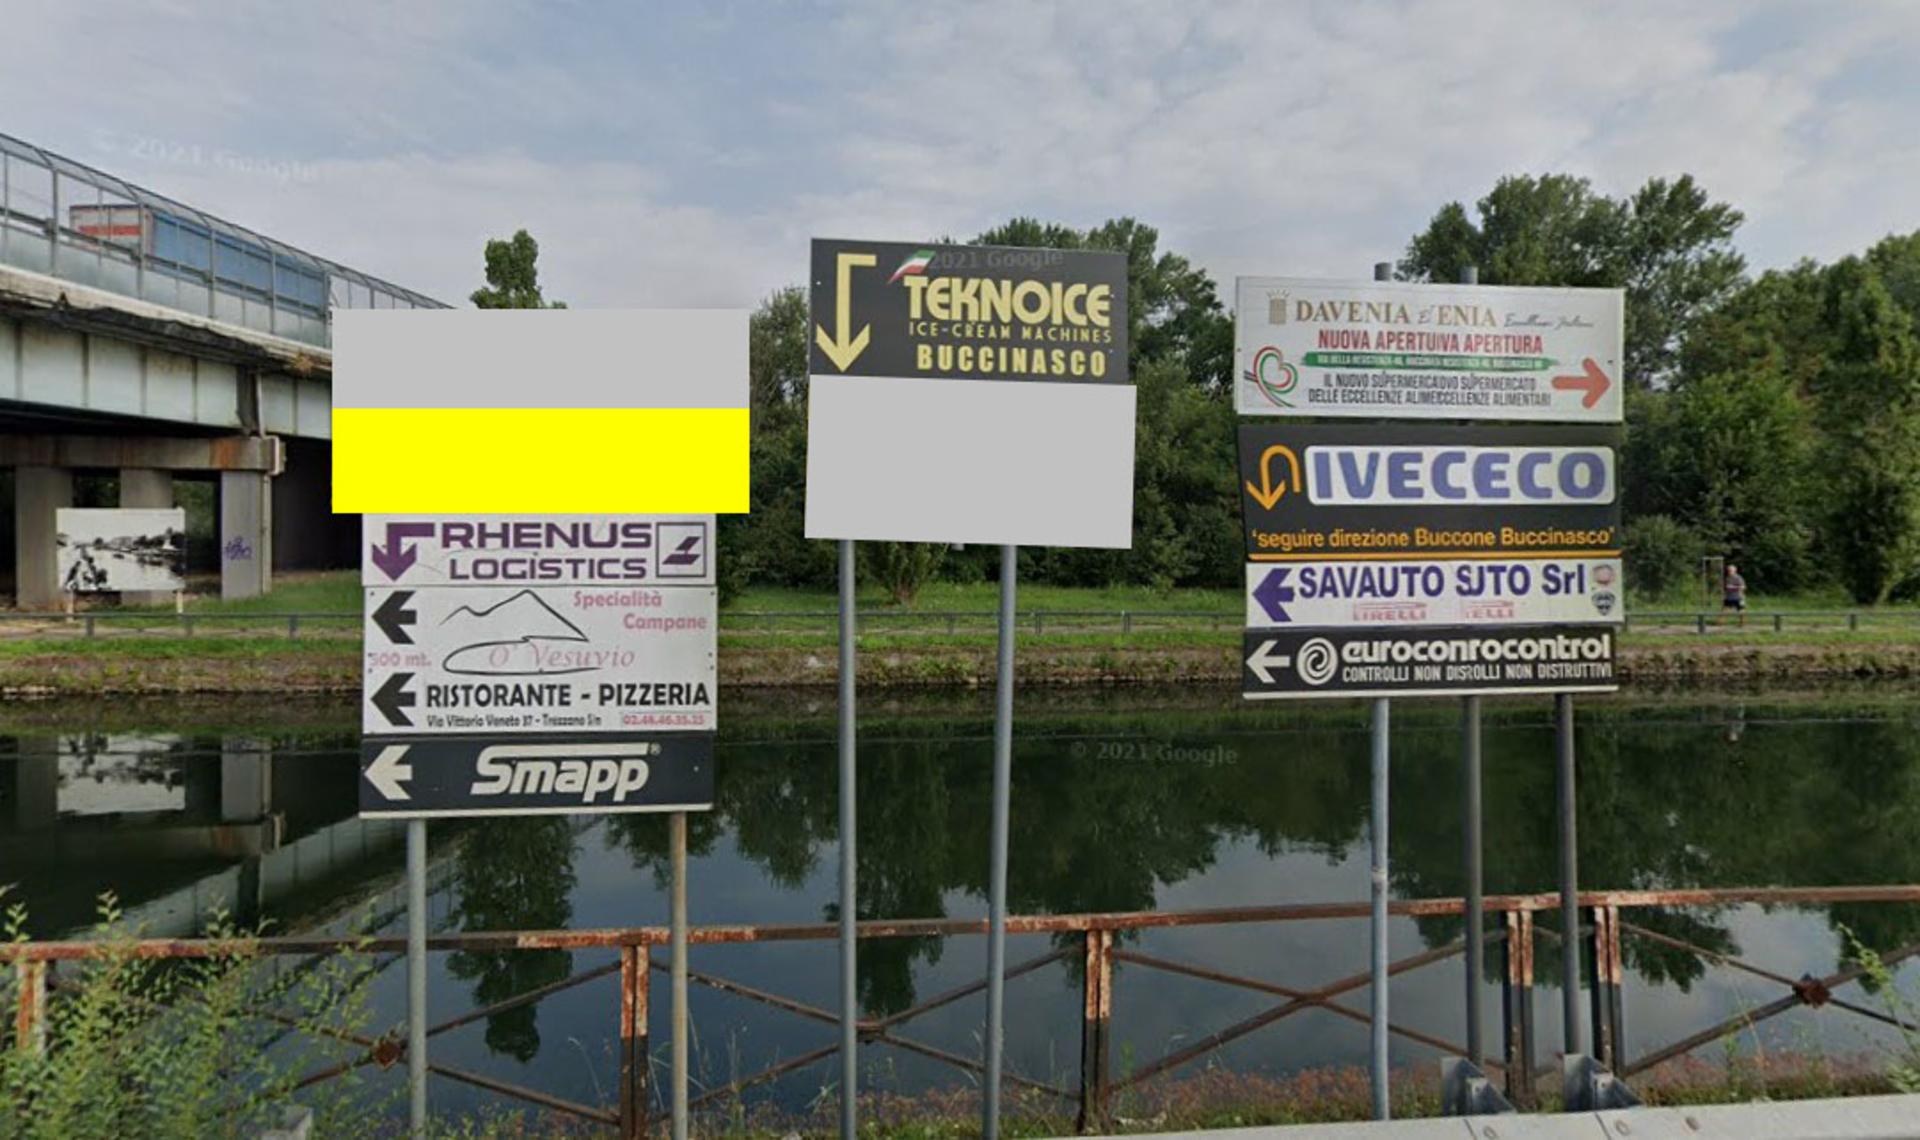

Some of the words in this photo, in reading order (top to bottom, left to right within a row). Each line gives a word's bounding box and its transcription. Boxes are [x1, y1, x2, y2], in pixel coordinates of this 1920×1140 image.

[903, 275, 1111, 327] TEKNOICE
[1296, 300, 1411, 324] DAVENIA
[1437, 304, 1496, 328] ENIA
[909, 321, 1011, 339] ICE-CREAM
[1022, 326, 1112, 343] MACHINES
[1318, 330, 1370, 350] NUOVA
[1463, 333, 1543, 354] APERTURA
[917, 344, 1106, 377] BUCCINASCO
[1336, 373, 1369, 388] NUOVO
[1308, 389, 1339, 403] DELLE
[1341, 390, 1403, 405] ECCELLENZE
[1312, 450, 1606, 500] IVECECO
[441, 522, 652, 549] RHENUS
[1329, 527, 1409, 547] direzione
[1415, 527, 1496, 546] Buccone
[450, 558, 646, 580] LOGISTICS
[1300, 565, 1444, 598] SAVAUTO
[1542, 563, 1585, 596] Srl
[573, 589, 662, 609] Specialità
[623, 613, 707, 632] Campane
[527, 640, 635, 668] Vesuvio
[1342, 666, 1409, 683] CONTROLLI
[1414, 665, 1441, 681] NON
[1506, 663, 1532, 680] NON
[1538, 662, 1612, 679] DISTRUTTIVI
[426, 684, 571, 708] RISTORANTE
[598, 682, 711, 707] PIZZERIA
[427, 715, 444, 727] Via
[446, 714, 484, 727] Vittorio
[485, 715, 520, 727] Veneto
[470, 742, 650, 803] Smapp
